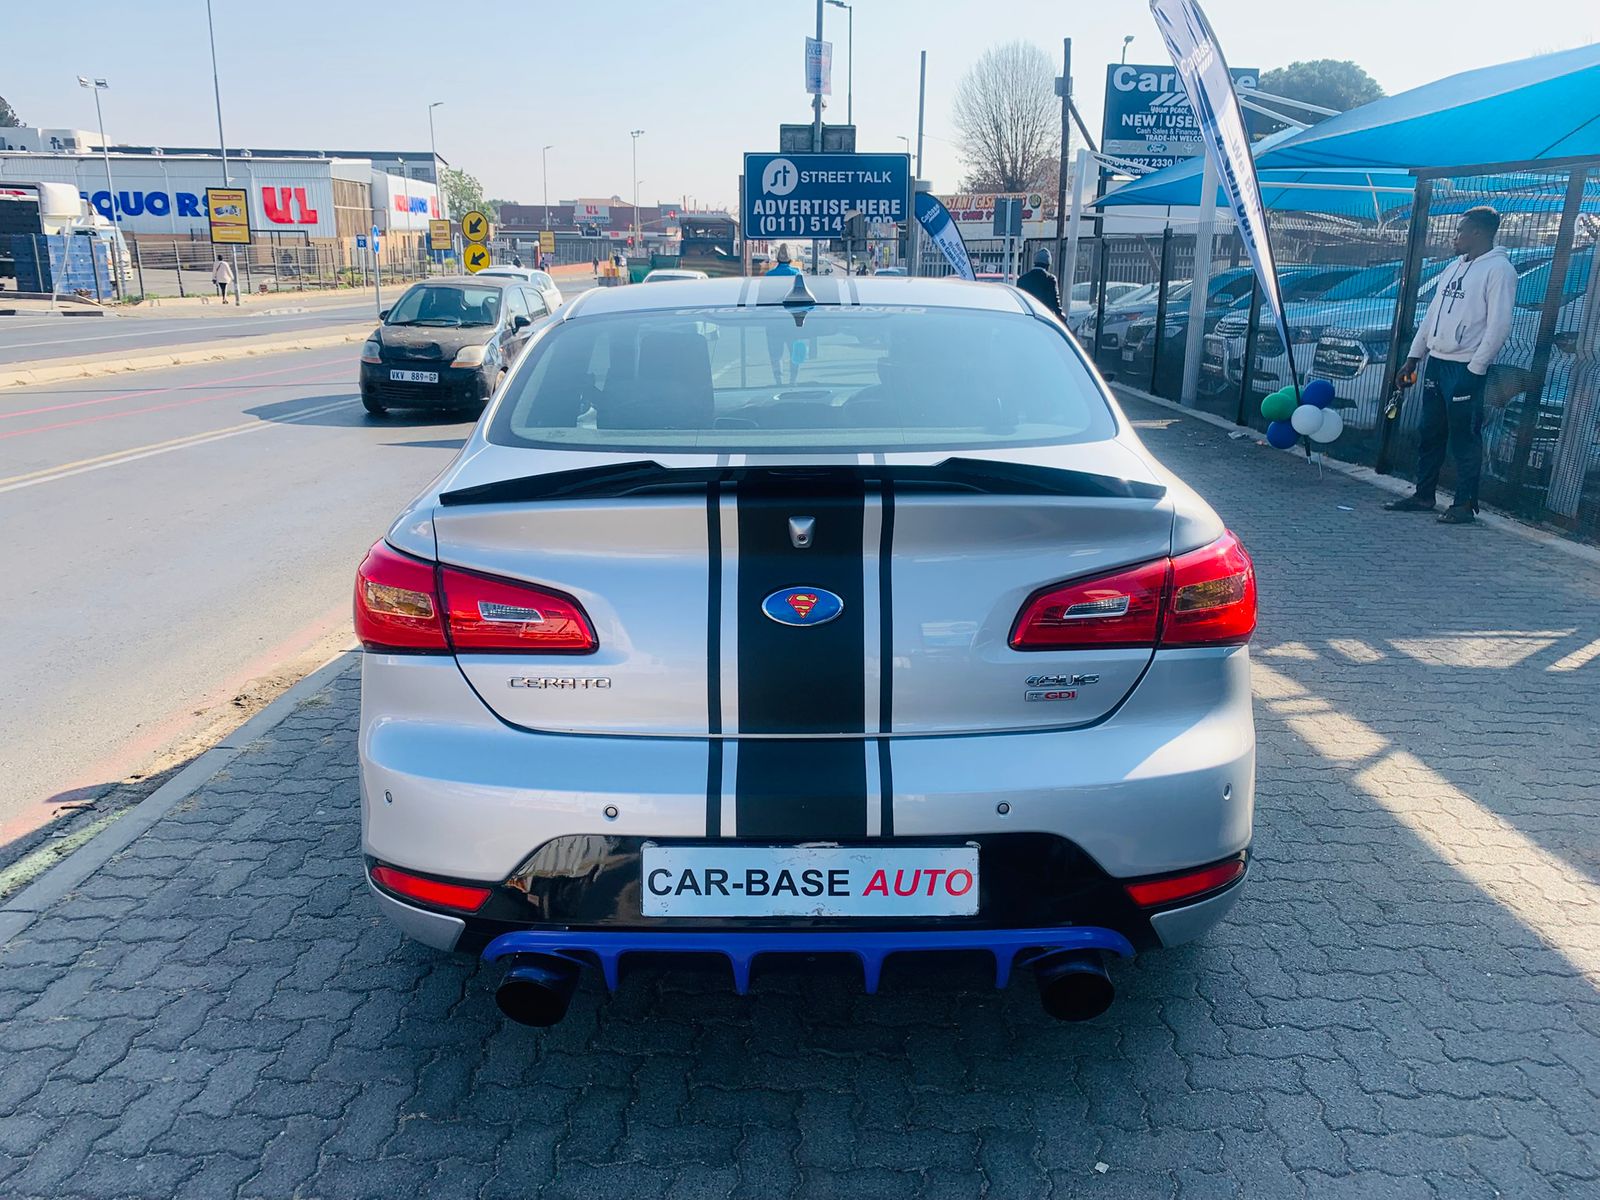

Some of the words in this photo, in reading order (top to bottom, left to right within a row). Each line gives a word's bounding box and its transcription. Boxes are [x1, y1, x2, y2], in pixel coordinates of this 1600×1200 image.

[1122, 114, 1156, 127] NEW
[1136, 127, 1151, 135] Cash
[1151, 158, 1173, 167] 2330
[800, 171, 855, 183] STREET
[856, 171, 892, 183] TALK
[261, 187, 319, 224] UL
[585, 204, 599, 215] UL
[753, 199, 850, 215] ADVERTISE
[856, 199, 901, 215] HERE
[920, 203, 941, 223] Carbase
[760, 216, 805, 235] (011)
[391, 371, 405, 380] VKV
[507, 676, 612, 690] CERATO
[647, 867, 850, 897] CAR-BASE
[862, 867, 974, 897] AUTO
